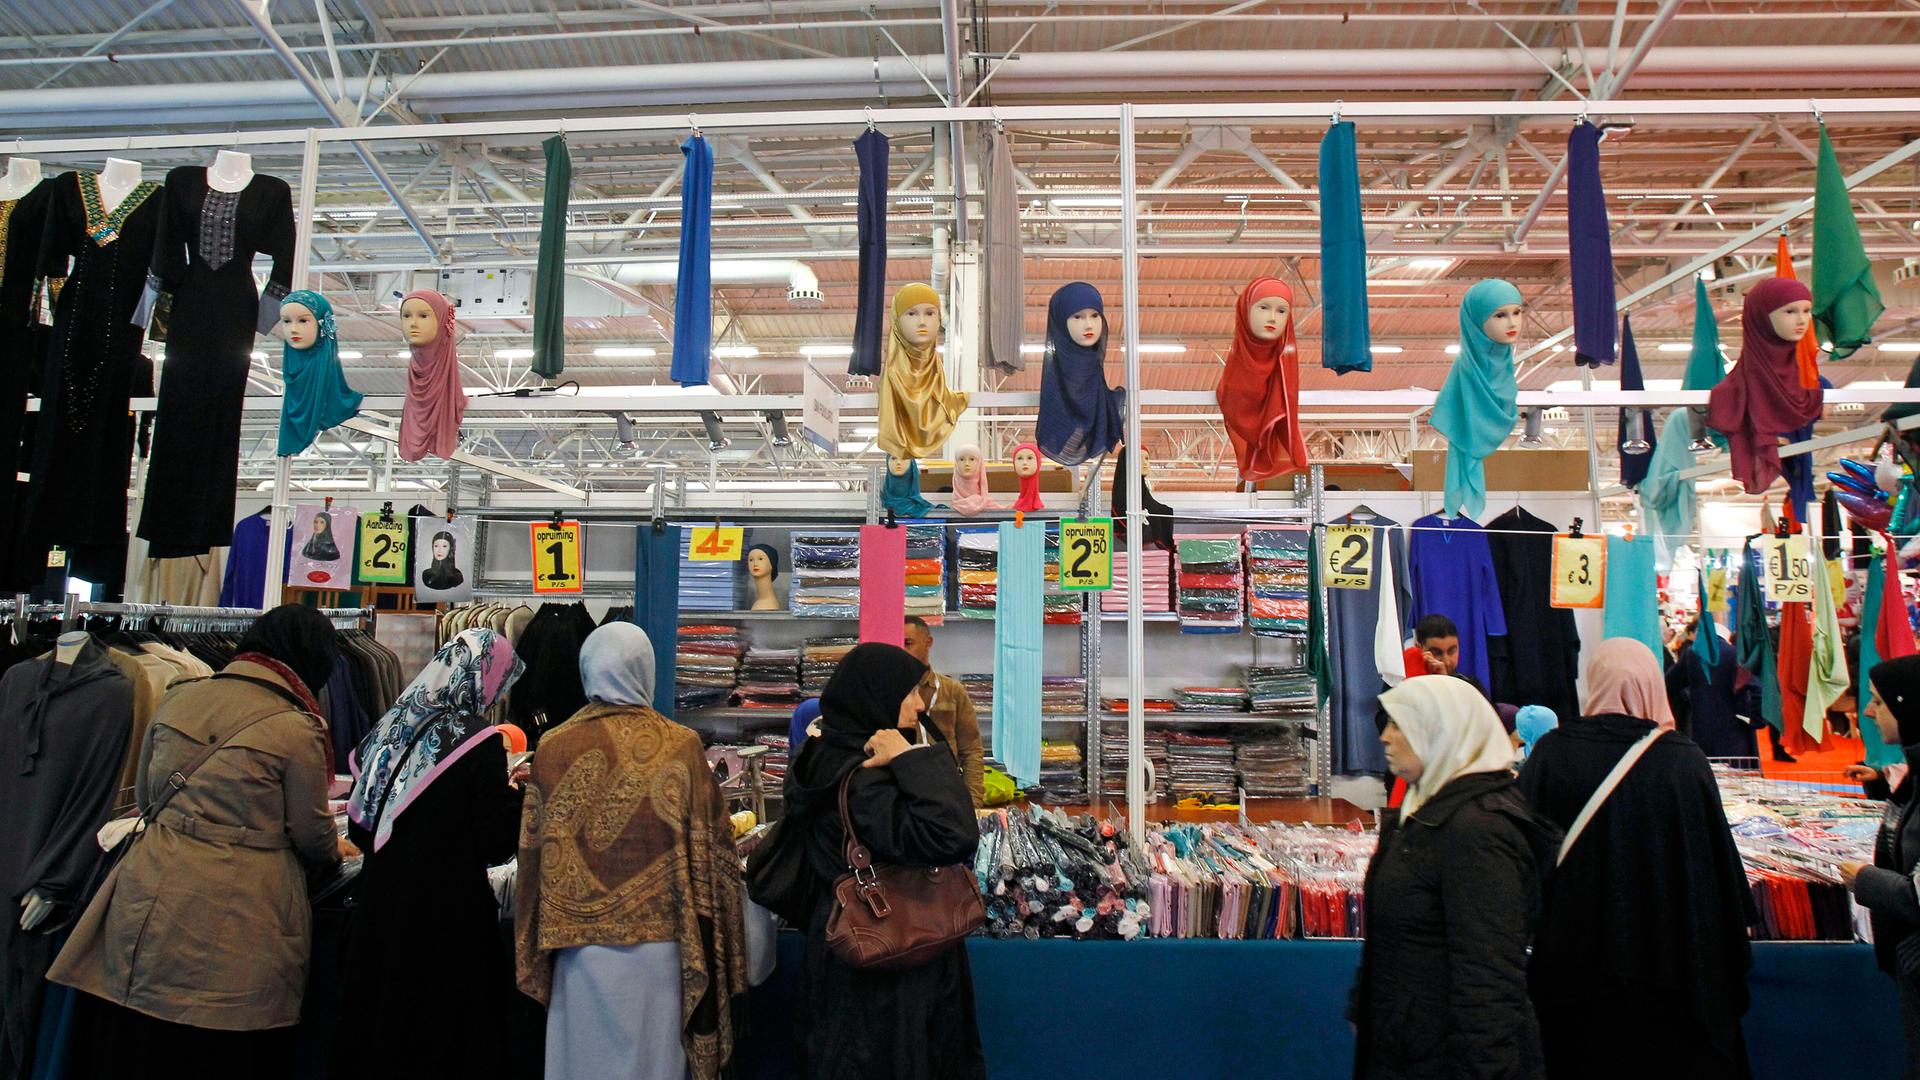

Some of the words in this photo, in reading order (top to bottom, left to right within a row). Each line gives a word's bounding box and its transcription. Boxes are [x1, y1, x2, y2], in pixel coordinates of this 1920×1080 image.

[537, 528, 574, 543] opruiming
[1065, 525, 1105, 540] opruiming
[1333, 578, 1366, 586] P/S
[1775, 584, 1809, 595] P/S
